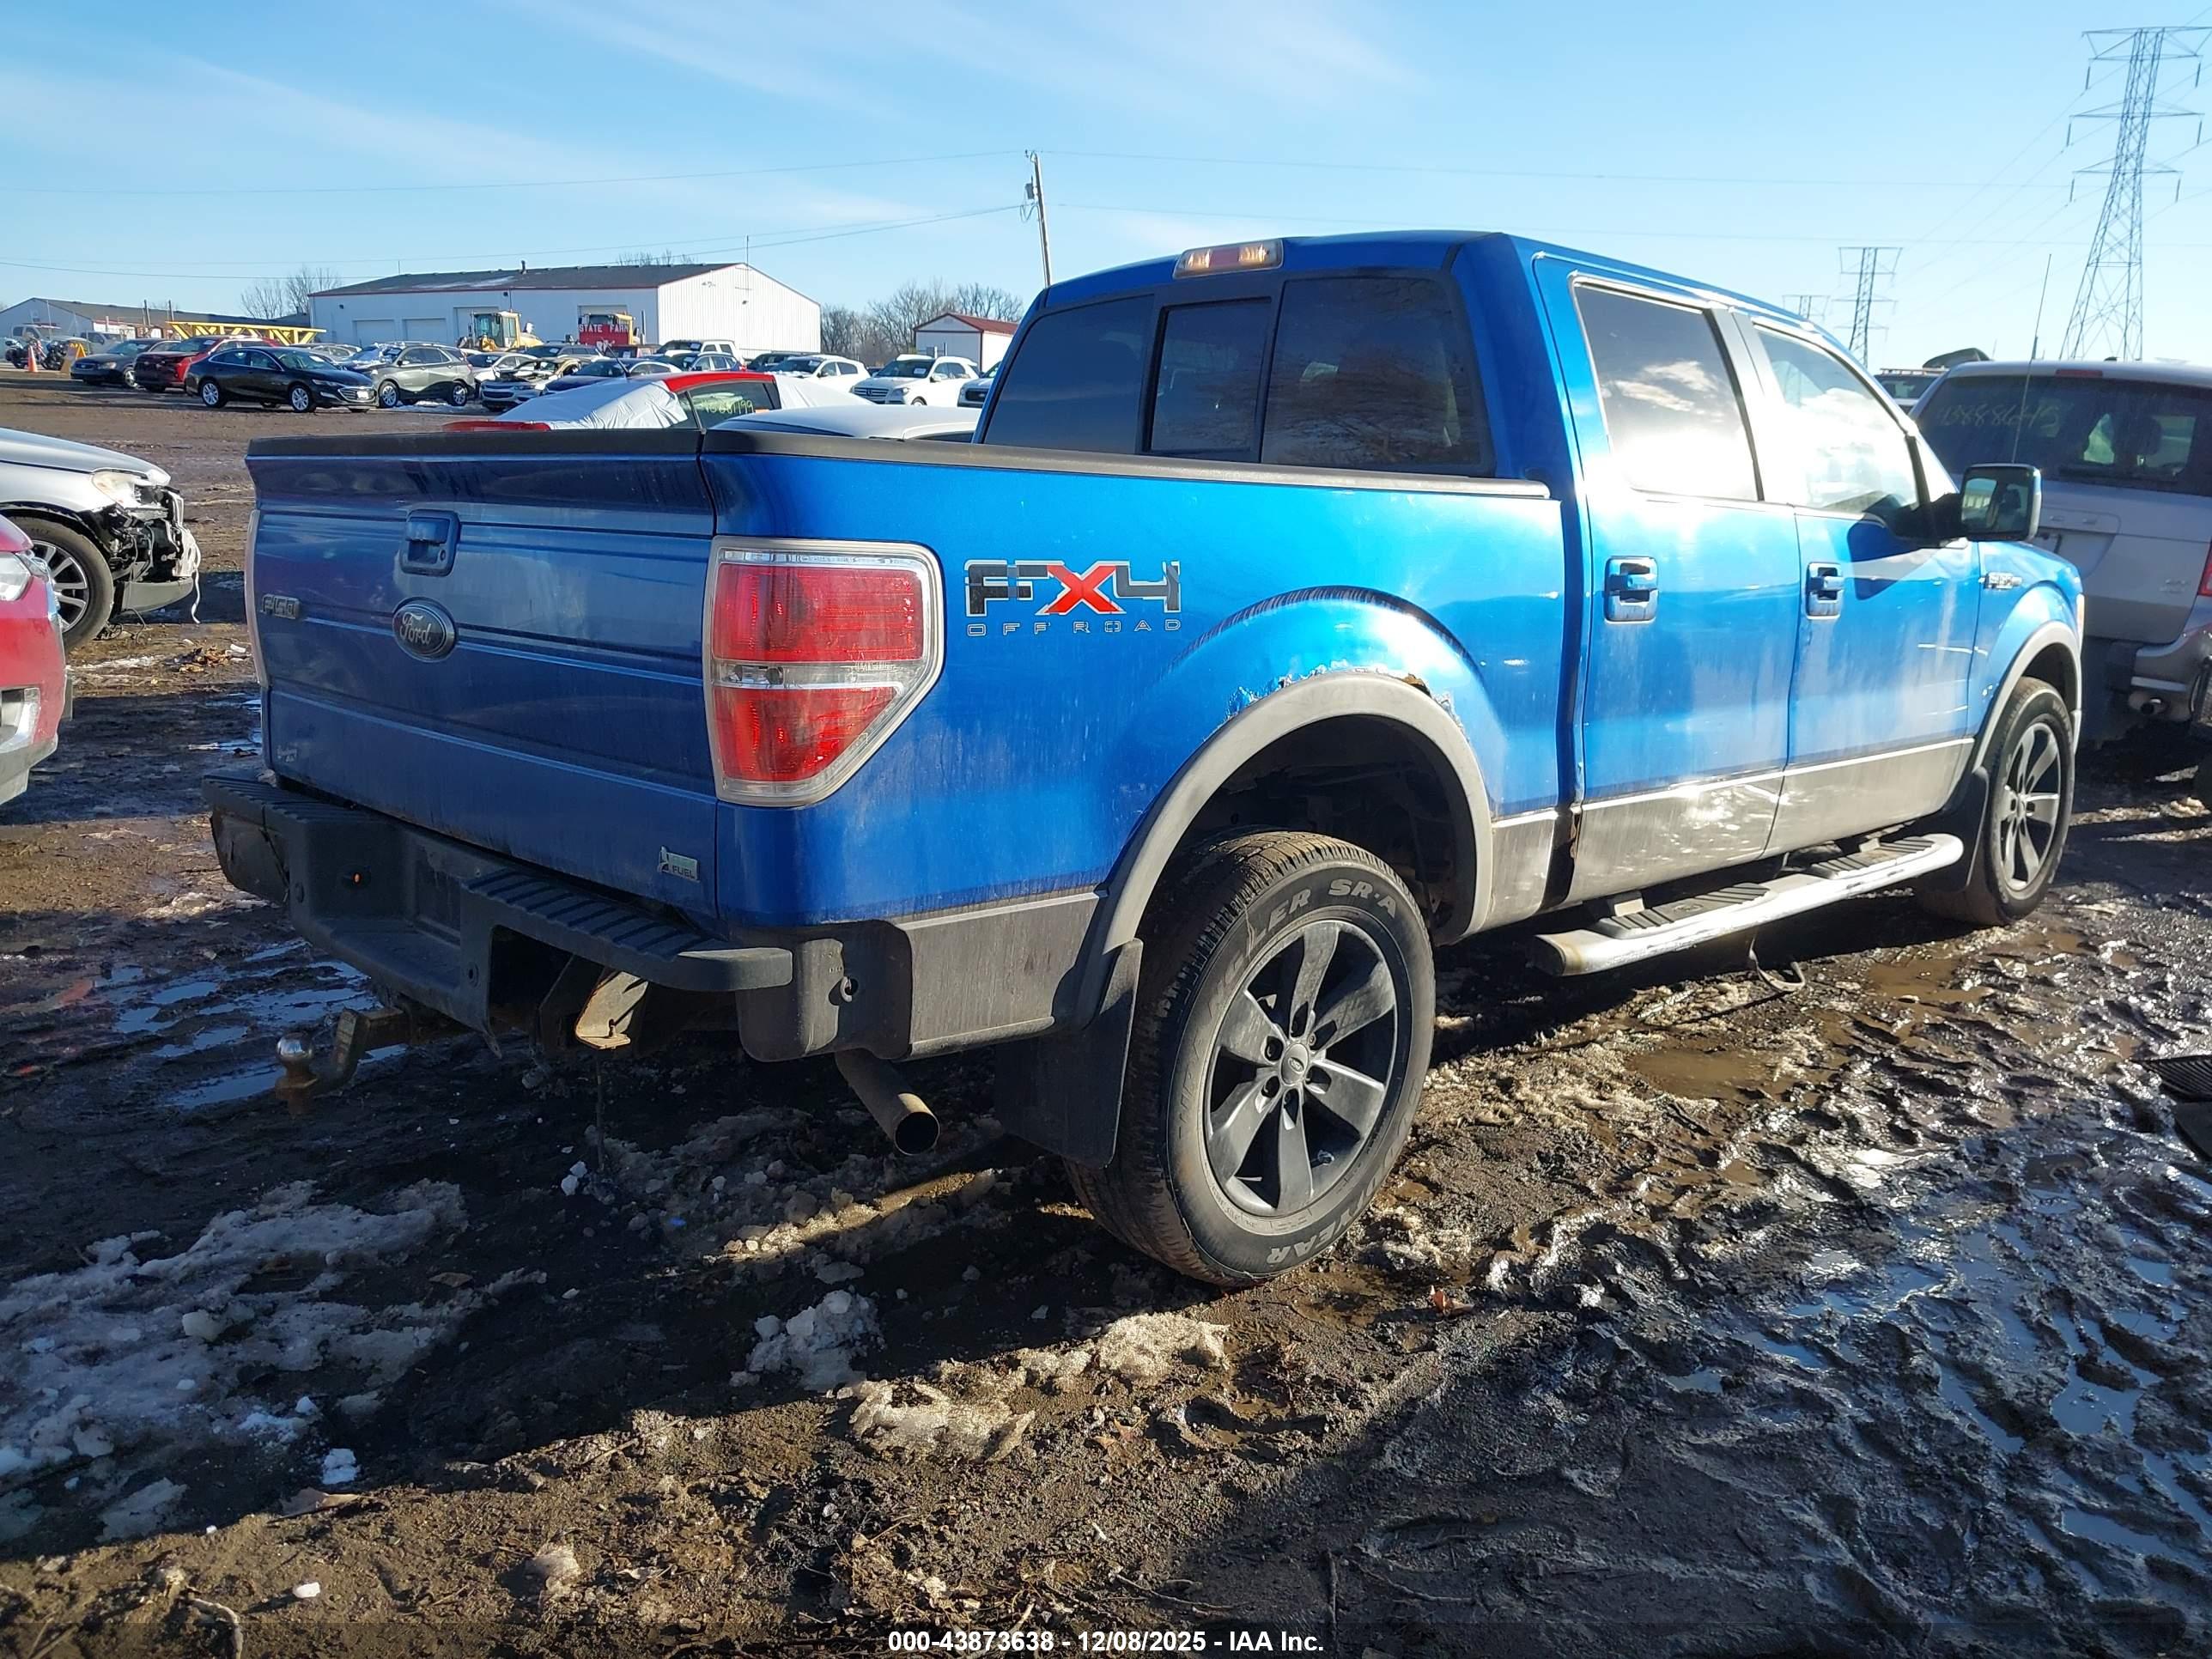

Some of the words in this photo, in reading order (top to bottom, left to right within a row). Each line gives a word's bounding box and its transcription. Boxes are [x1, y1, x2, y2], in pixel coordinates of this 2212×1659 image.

[579, 324, 603, 333] STATE
[964, 560, 1182, 617] FX4
[399, 612, 433, 645] Ford
[672, 865, 696, 879] FUEL
